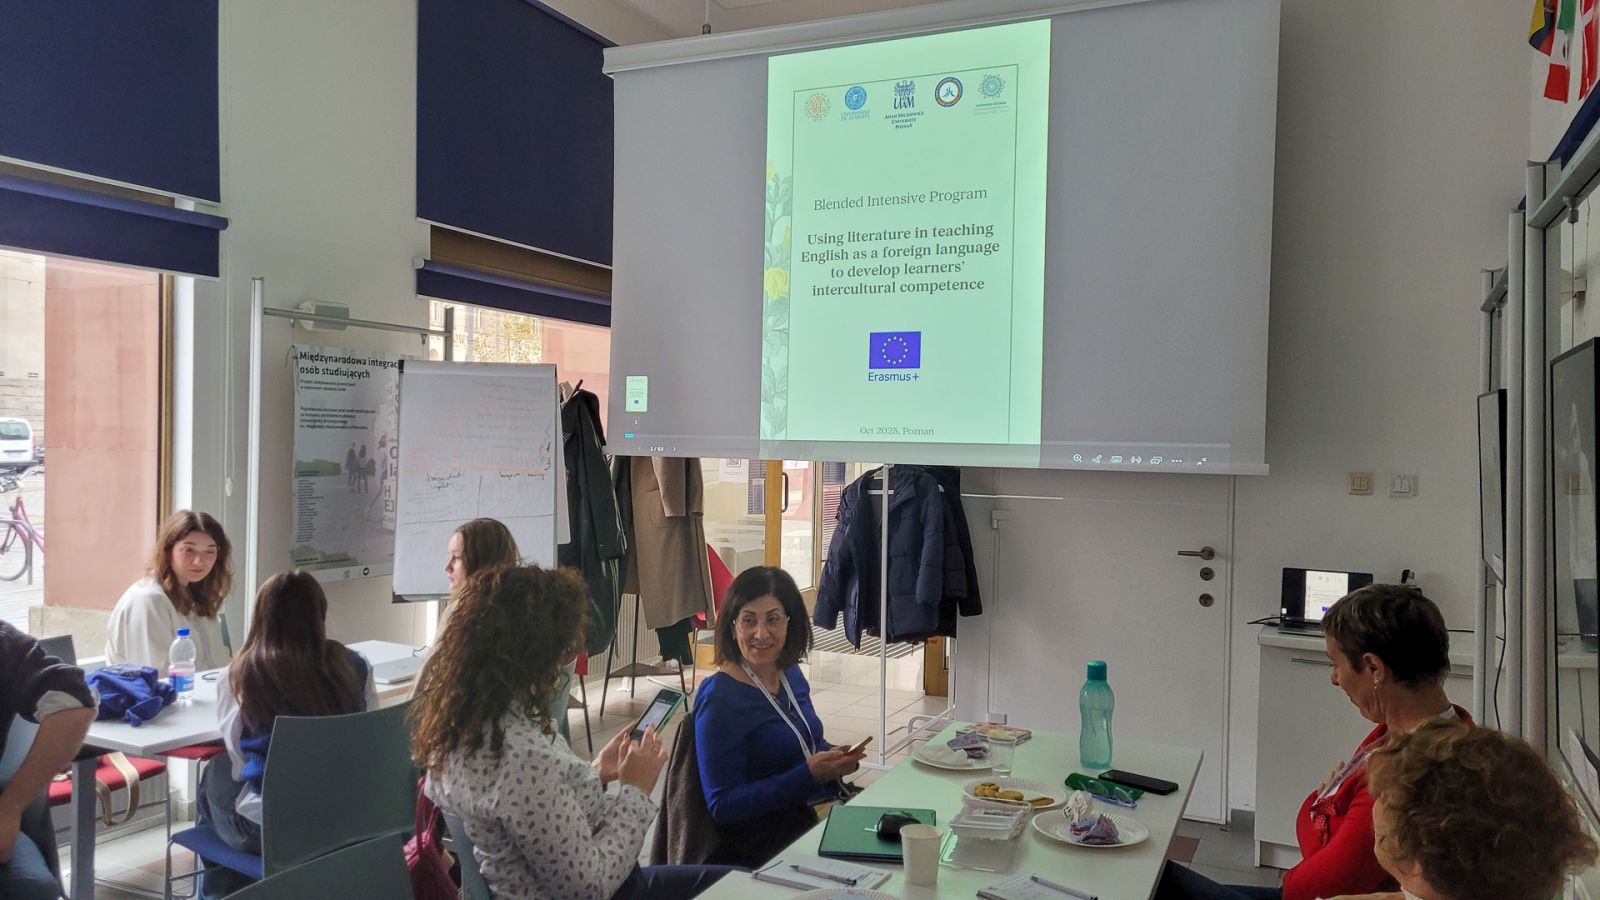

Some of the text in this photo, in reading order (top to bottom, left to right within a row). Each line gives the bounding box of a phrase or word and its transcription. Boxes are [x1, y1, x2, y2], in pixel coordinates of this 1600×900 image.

[813, 188, 988, 211] Blended Intensive Program
[807, 223, 994, 247] Using literature in teaching
[801, 241, 1000, 265] English as a foreign language
[830, 267, 844, 279] to
[847, 263, 900, 278] develop
[812, 279, 985, 297] intercultural competence
[299, 351, 367, 366] Międzynarodowa
[299, 365, 370, 380] osób studiujących
[868, 372, 920, 382] Erasmus+
[860, 427, 934, 436] Oct 2025, Poznan
